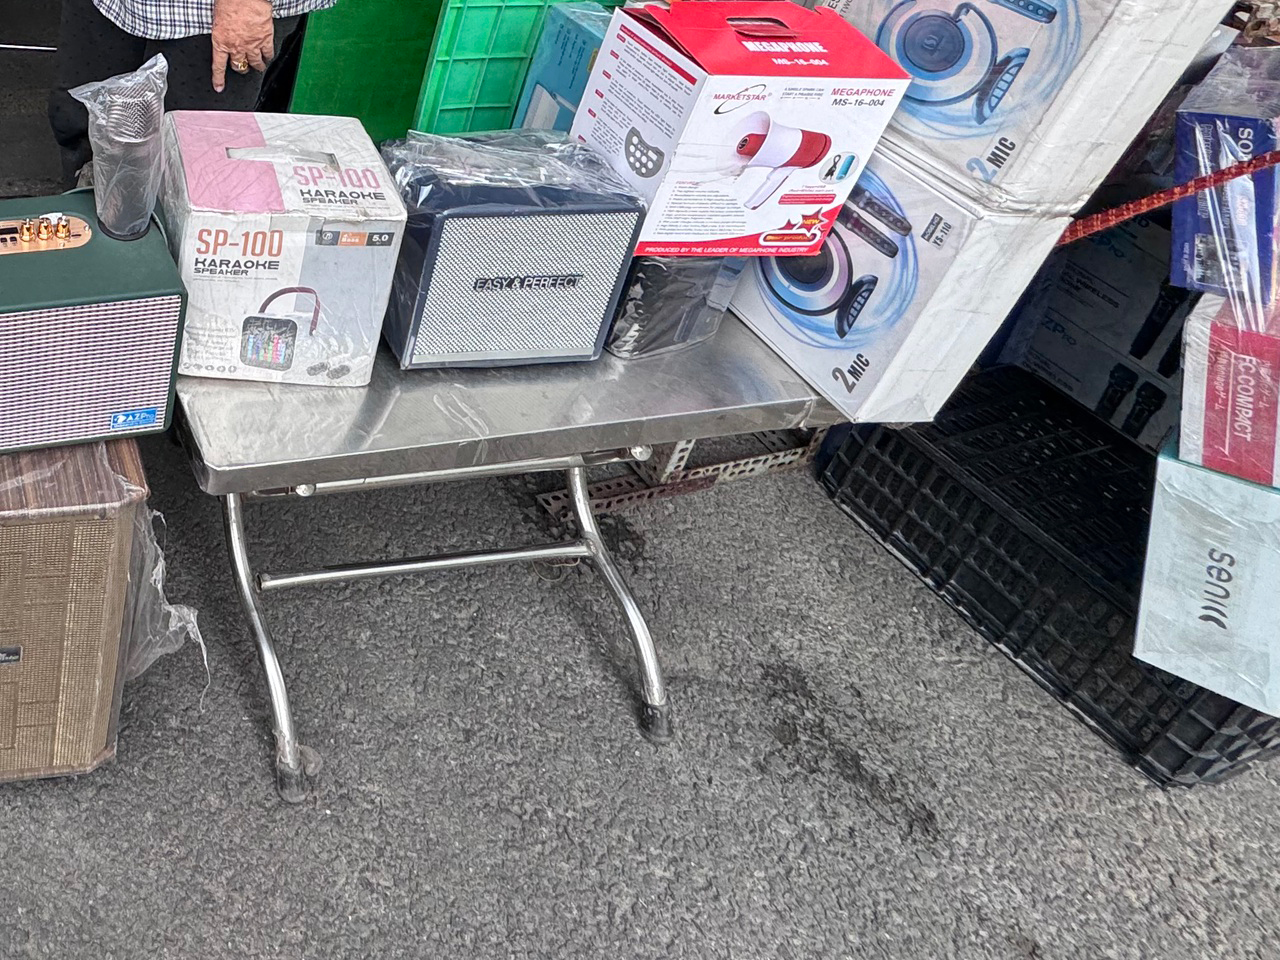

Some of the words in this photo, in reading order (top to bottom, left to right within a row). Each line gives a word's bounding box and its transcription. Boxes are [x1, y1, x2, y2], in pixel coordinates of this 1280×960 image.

[741, 41, 828, 53] MEGAPHONE
[772, 58, 829, 66] MS-16-004
[713, 93, 766, 101] MARKETSTAR
[831, 88, 896, 97] MEGAPHONE
[987, 136, 1016, 169] MIC
[294, 165, 381, 189] SP-100
[300, 189, 386, 201] KARAOKE
[196, 228, 283, 258] SP-100
[194, 258, 280, 270] KARAOKE
[194, 268, 249, 276] SPEAKER
[475, 278, 510, 291] EASY
[524, 274, 584, 289] PERFECT
[832, 367, 856, 394] 2
[847, 353, 870, 381] MIC
[126, 411, 155, 422] AZPro
